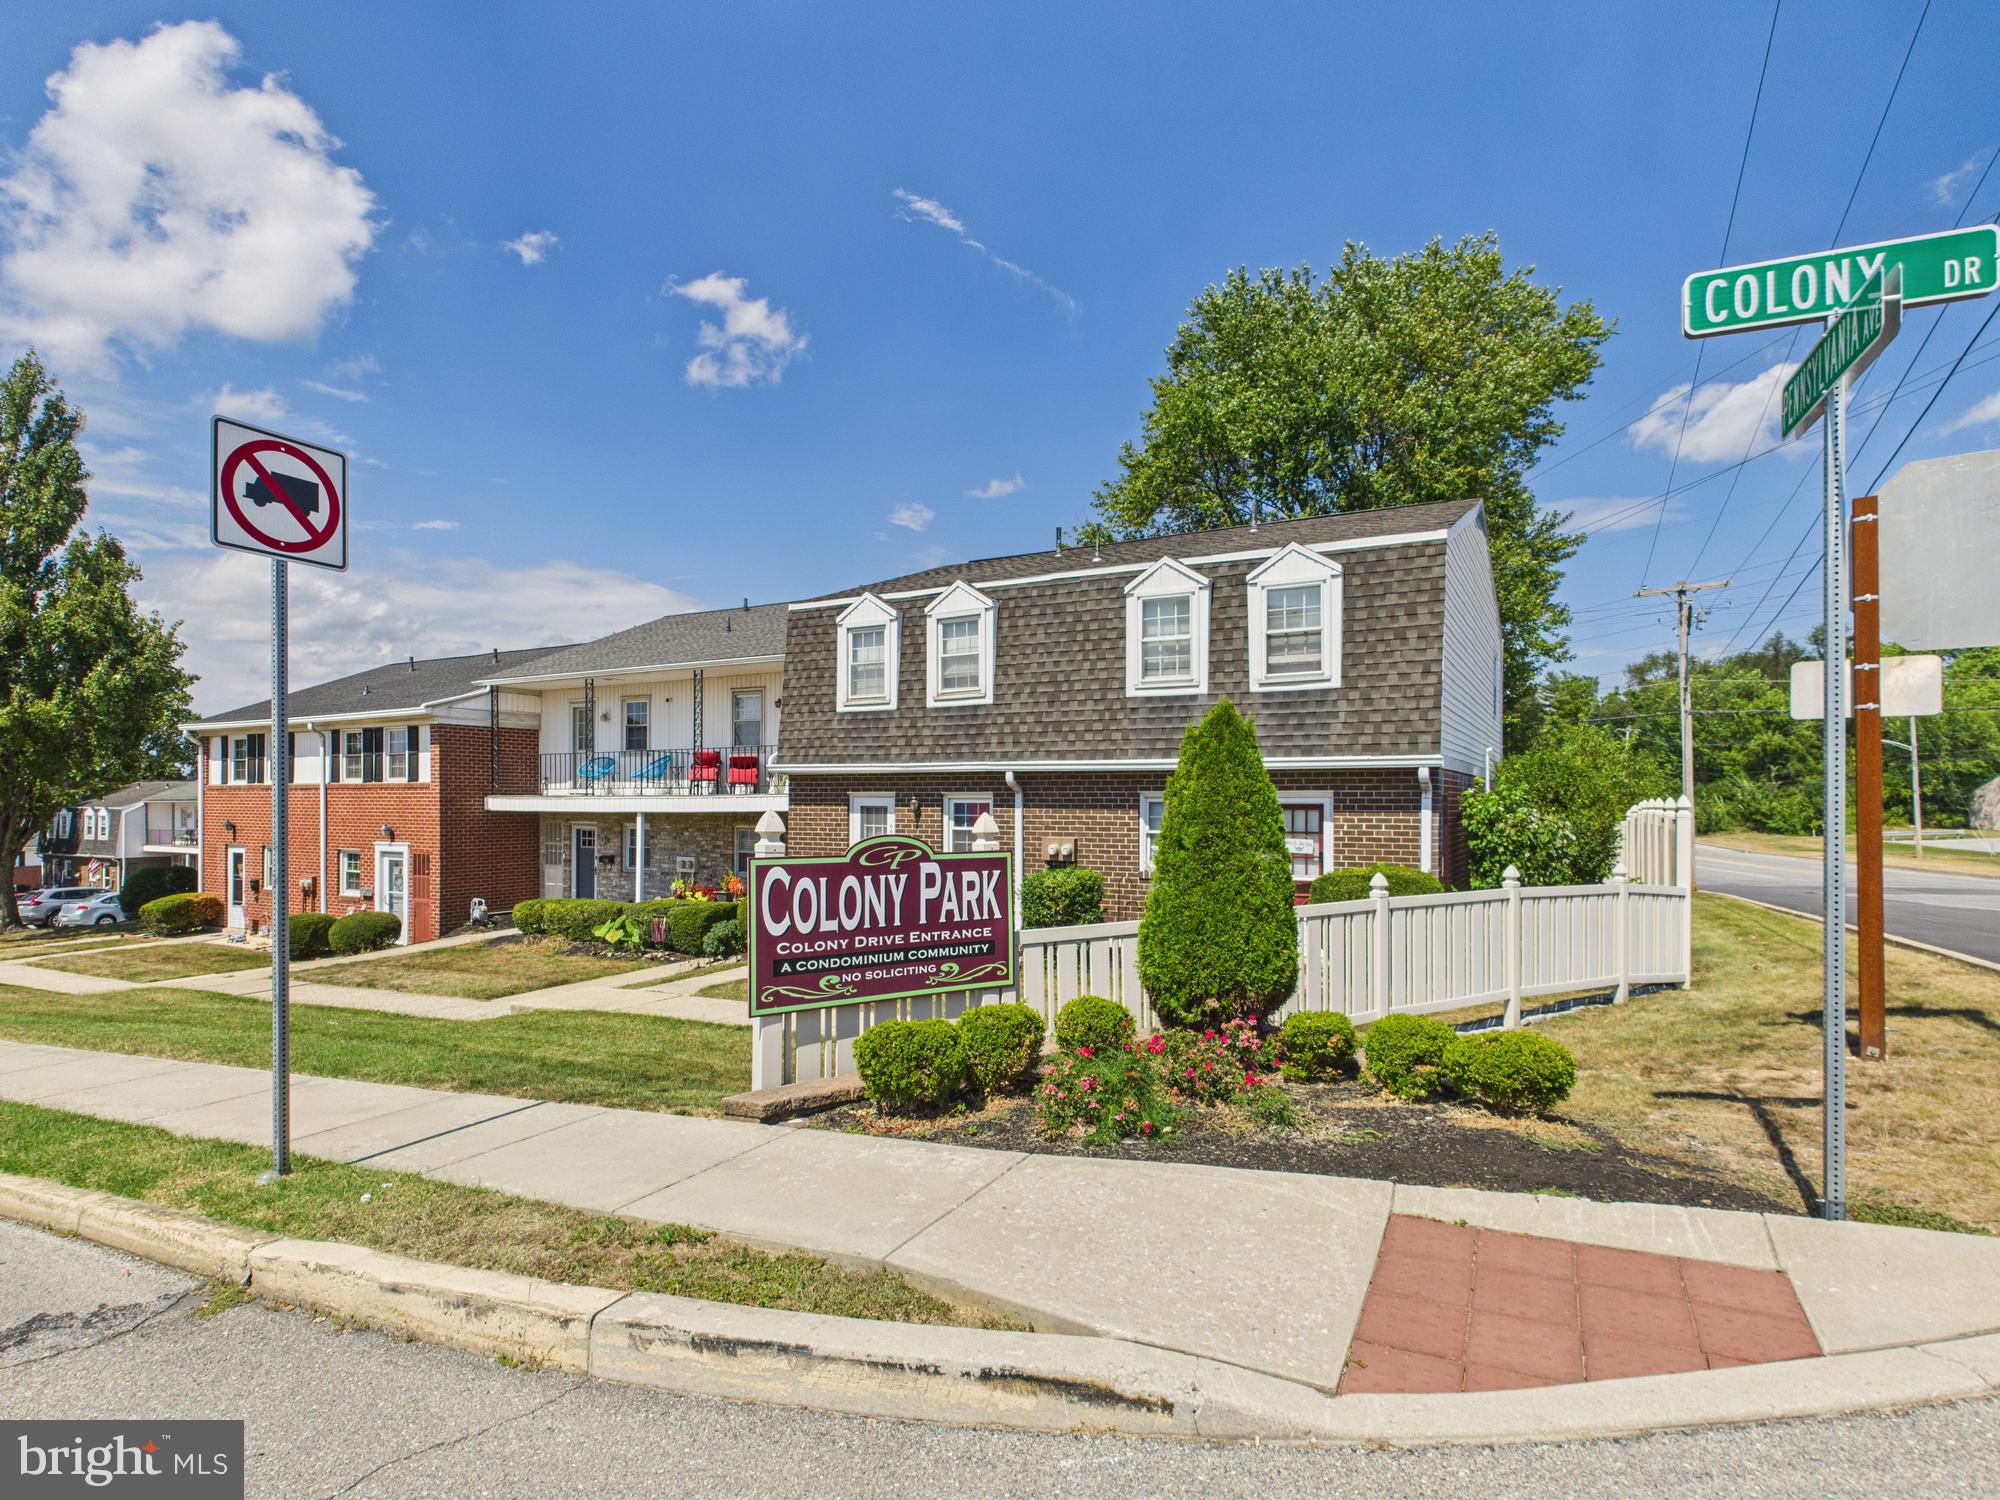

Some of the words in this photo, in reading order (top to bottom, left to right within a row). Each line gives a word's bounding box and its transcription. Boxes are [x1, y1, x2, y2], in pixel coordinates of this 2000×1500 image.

[1705, 252, 1886, 323] COLONY
[1944, 256, 1982, 288] DR
[1782, 304, 1860, 430] PENNSYLVANIA
[1862, 299, 1881, 344] AVE
[761, 866, 909, 937] COLONY
[919, 862, 1003, 925] PARK
[776, 938, 849, 955] COLONY
[854, 934, 904, 948] DRIVE
[909, 927, 992, 943] ENTRANCE
[780, 962, 792, 973] A
[796, 951, 904, 971] CONDOMINIUM
[908, 943, 990, 960] COMMUNITY
[842, 972, 862, 982] NO
[865, 964, 937, 980] SOLICITING
